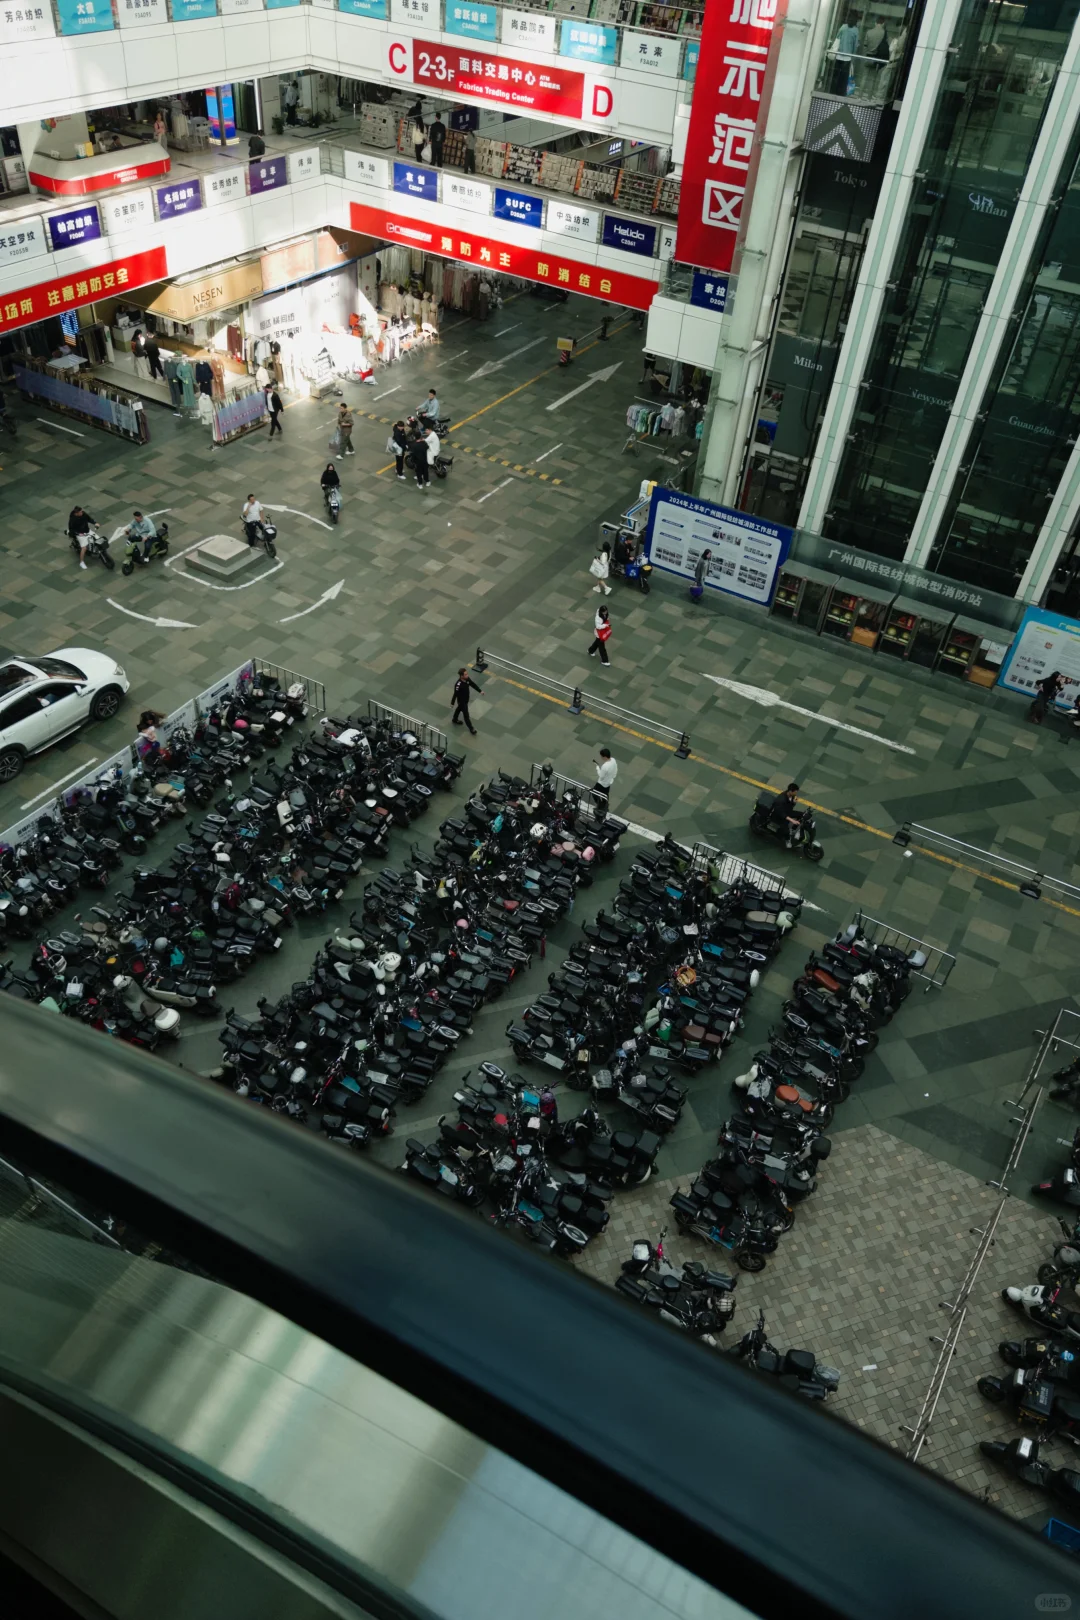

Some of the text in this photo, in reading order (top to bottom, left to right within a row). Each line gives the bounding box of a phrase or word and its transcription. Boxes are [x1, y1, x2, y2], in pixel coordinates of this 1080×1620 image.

[388, 42, 408, 74] C
[418, 53, 455, 82] 2-3F
[459, 56, 536, 87] 面料交易中心
[458, 82, 535, 104] Fabrics Trading Center
[591, 85, 613, 118] D
[833, 169, 868, 189] Tokyo
[505, 197, 532, 212] SUFC
[613, 224, 645, 241] Helida
[47, 267, 129, 307] 注意消防安全
[537, 261, 612, 294] 防消结合
[192, 286, 223, 305] NESEN
[793, 354, 823, 373] Milan
[909, 386, 949, 408] Newyor
[828, 548, 983, 607] 广州国际轻纺城微型消防站
